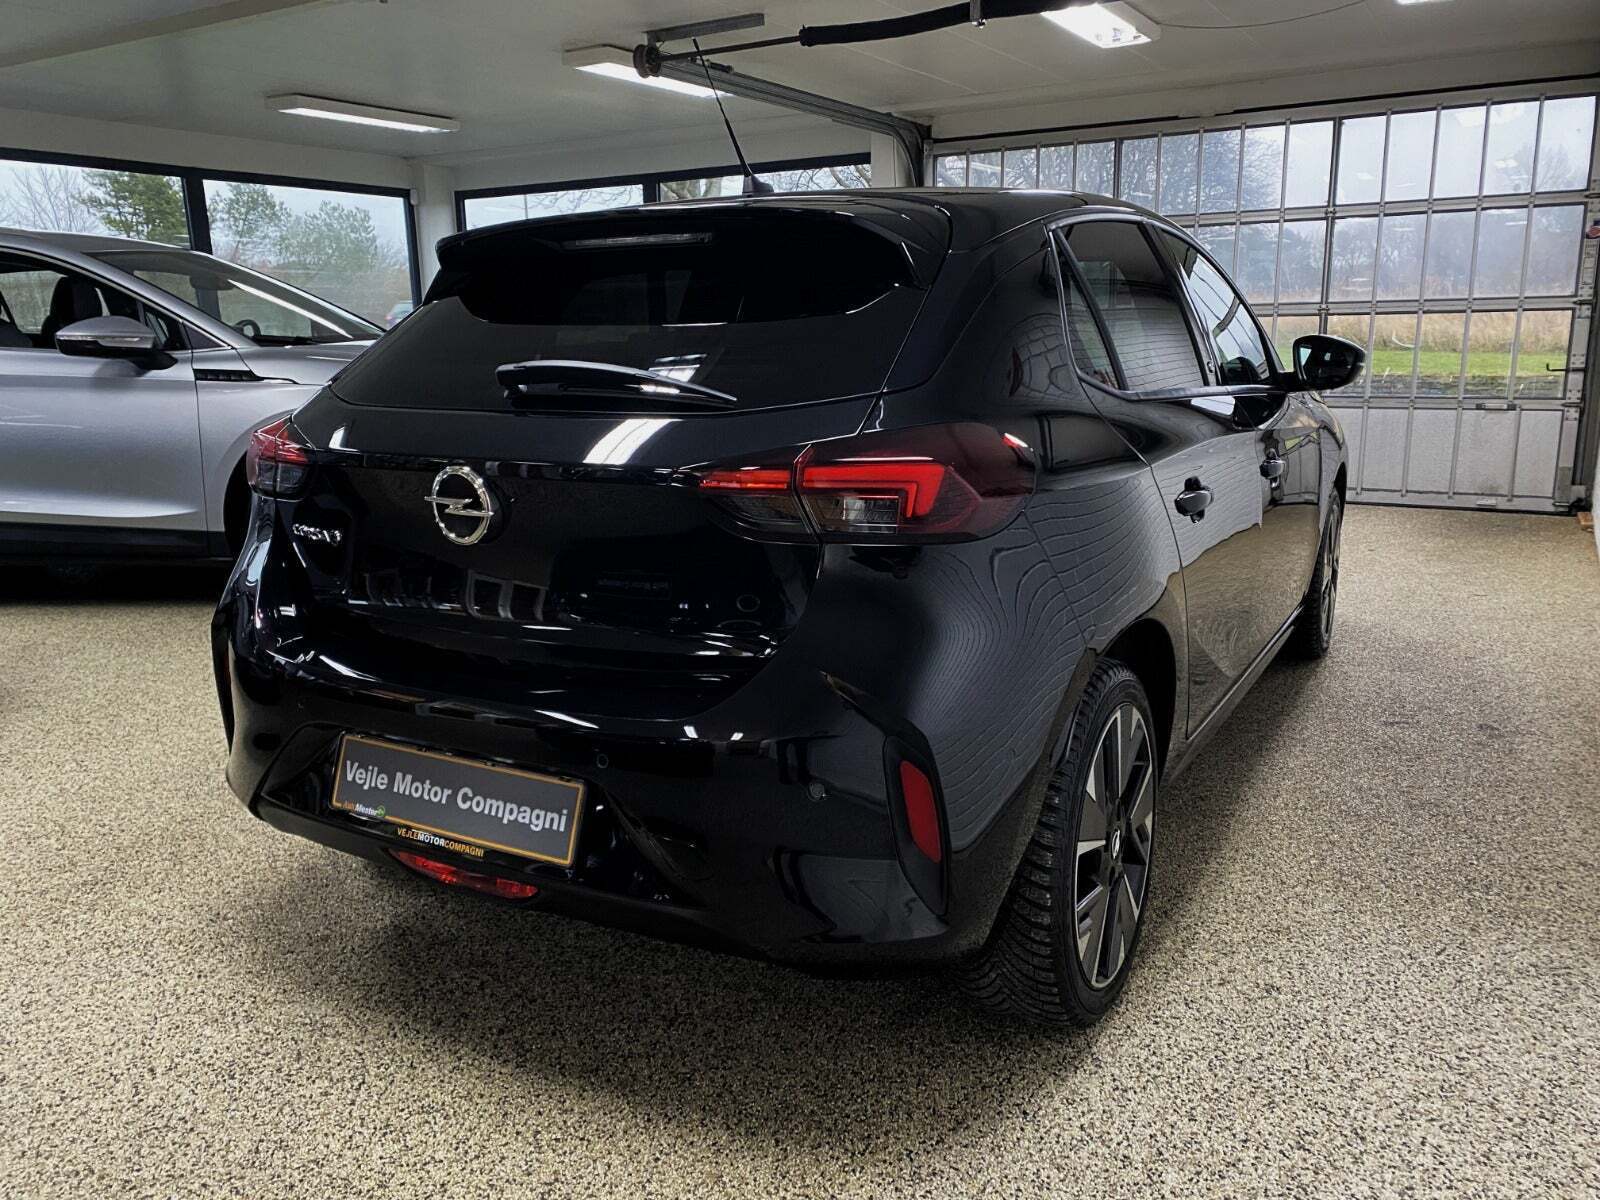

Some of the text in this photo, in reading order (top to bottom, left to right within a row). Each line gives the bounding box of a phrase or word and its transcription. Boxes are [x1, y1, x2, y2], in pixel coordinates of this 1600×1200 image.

[346, 760, 568, 832] Vejle Motor Compagni
